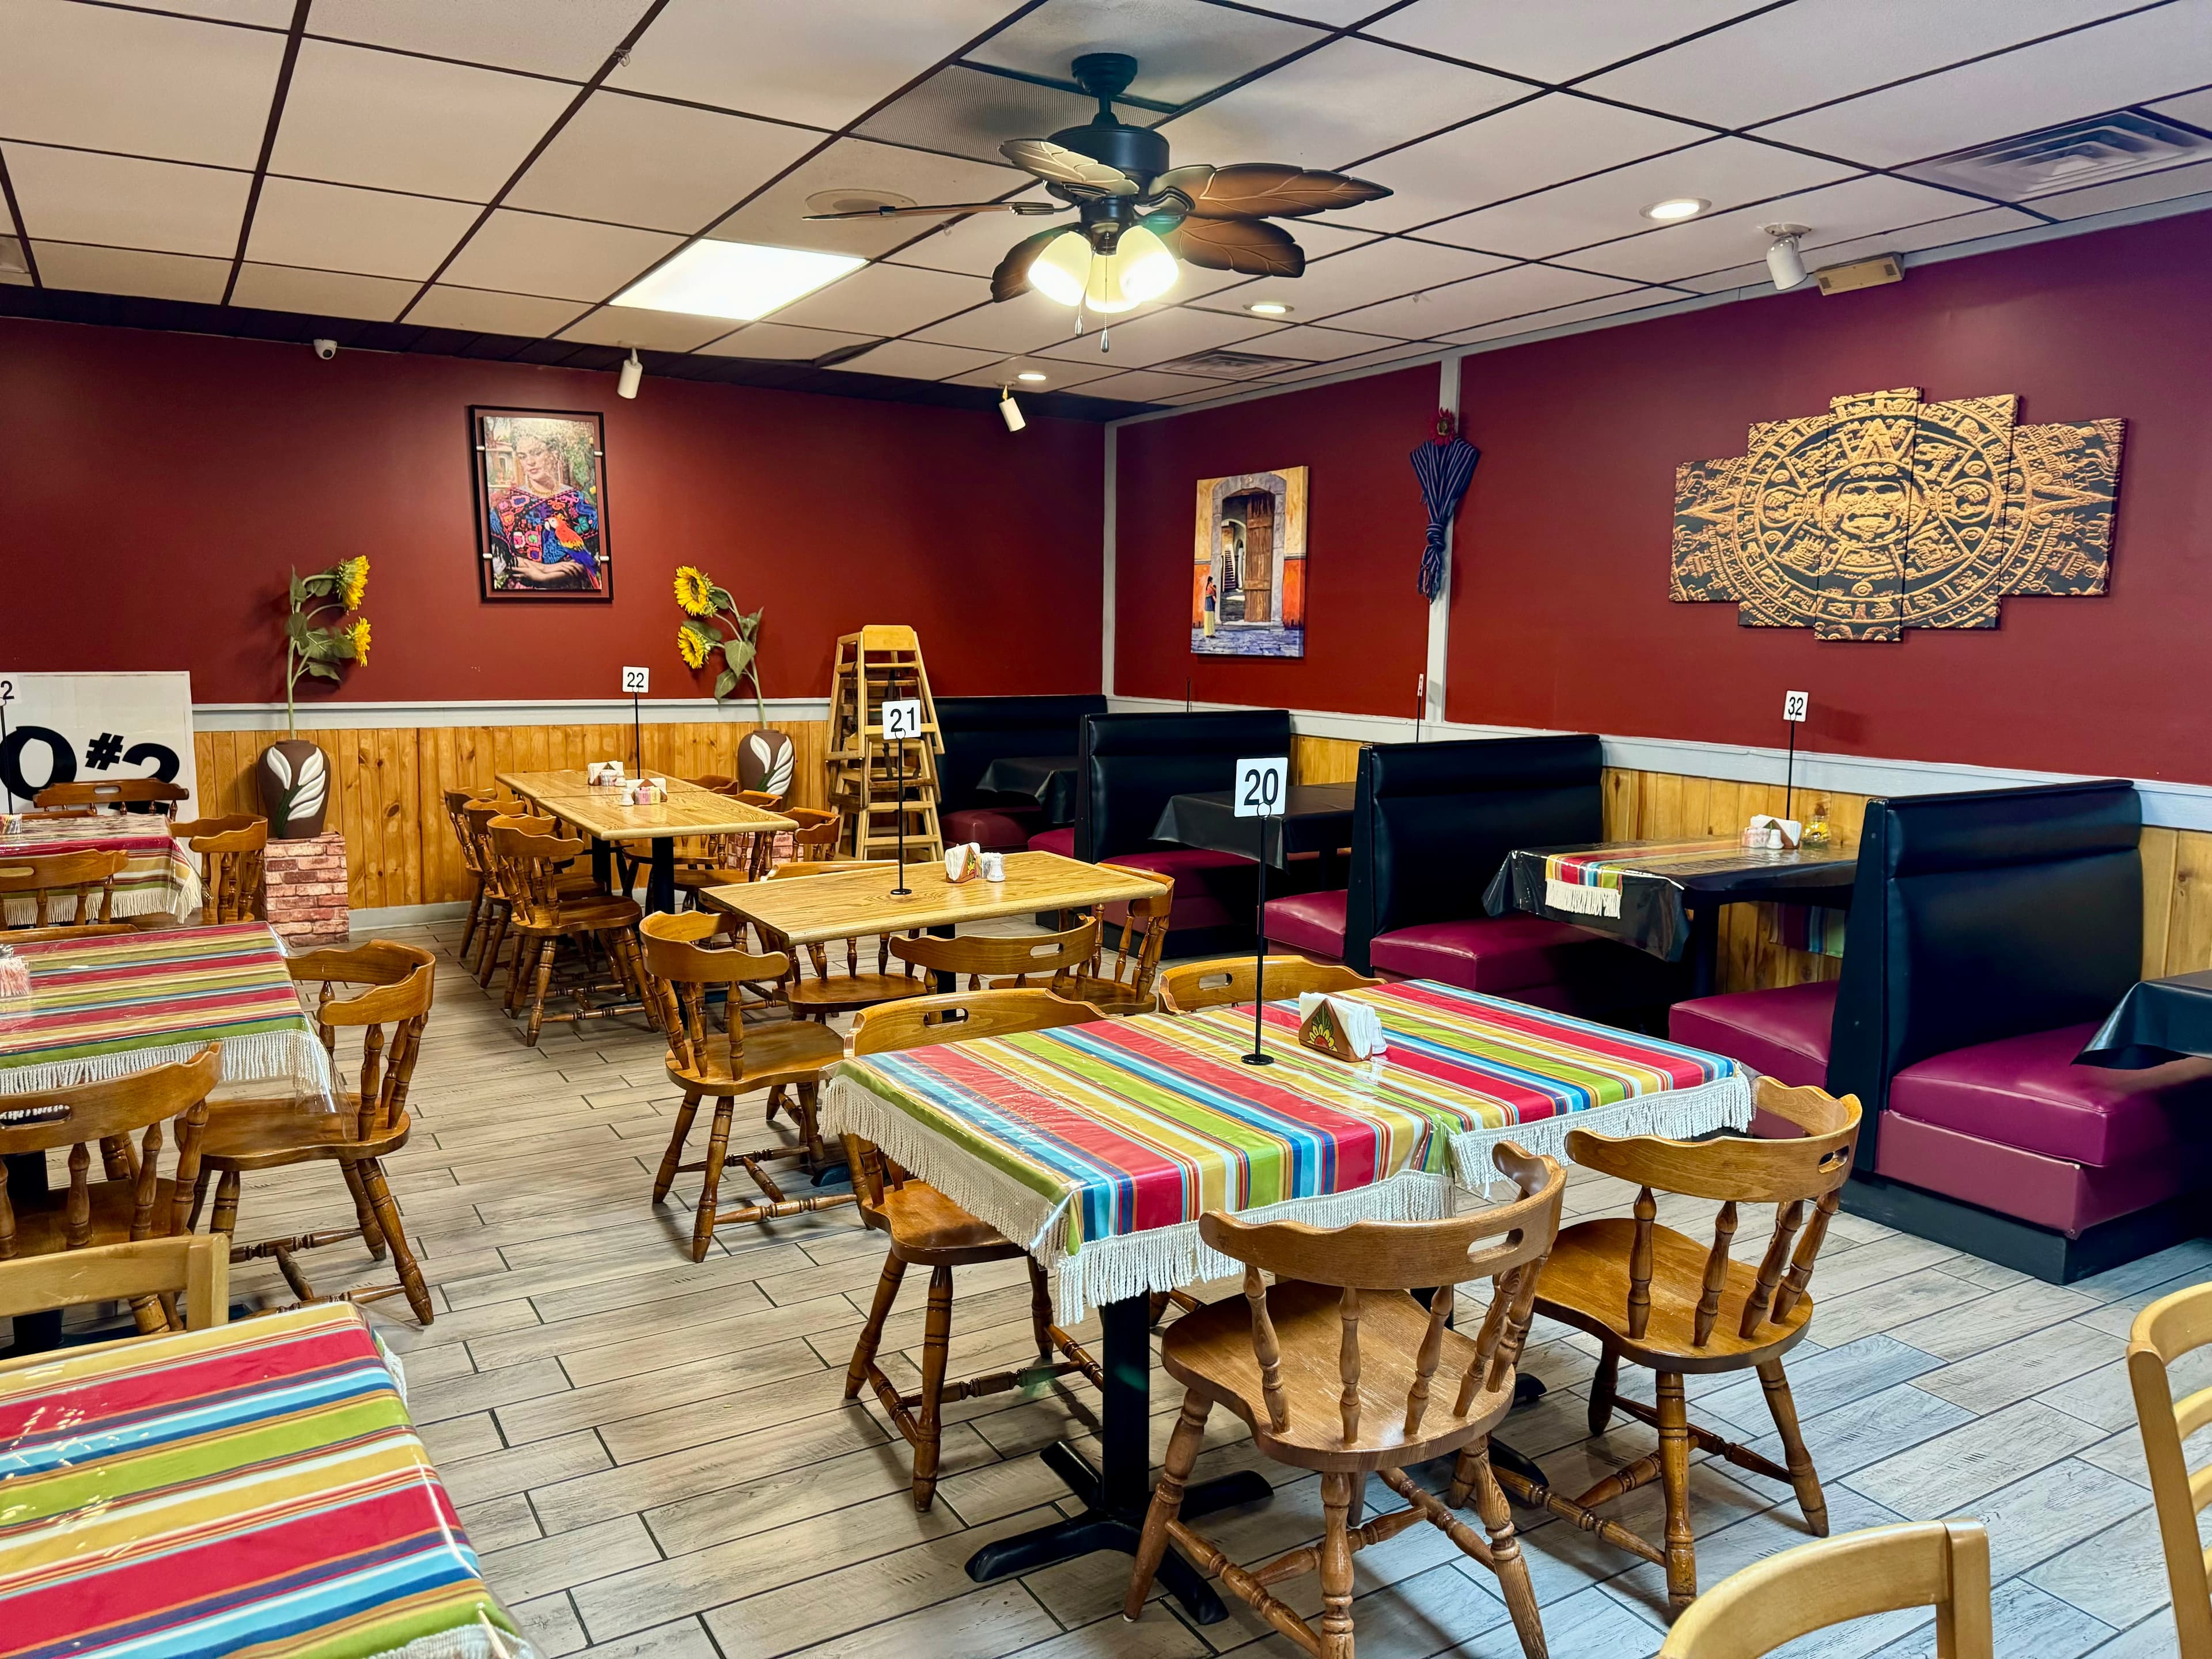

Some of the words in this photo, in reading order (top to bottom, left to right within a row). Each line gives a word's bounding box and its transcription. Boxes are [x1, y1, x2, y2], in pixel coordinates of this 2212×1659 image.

[0, 680, 14, 700] 2
[627, 672, 644, 688] 22
[1788, 696, 1804, 716] 32
[890, 707, 915, 732] 21
[1244, 768, 1278, 806] 20
